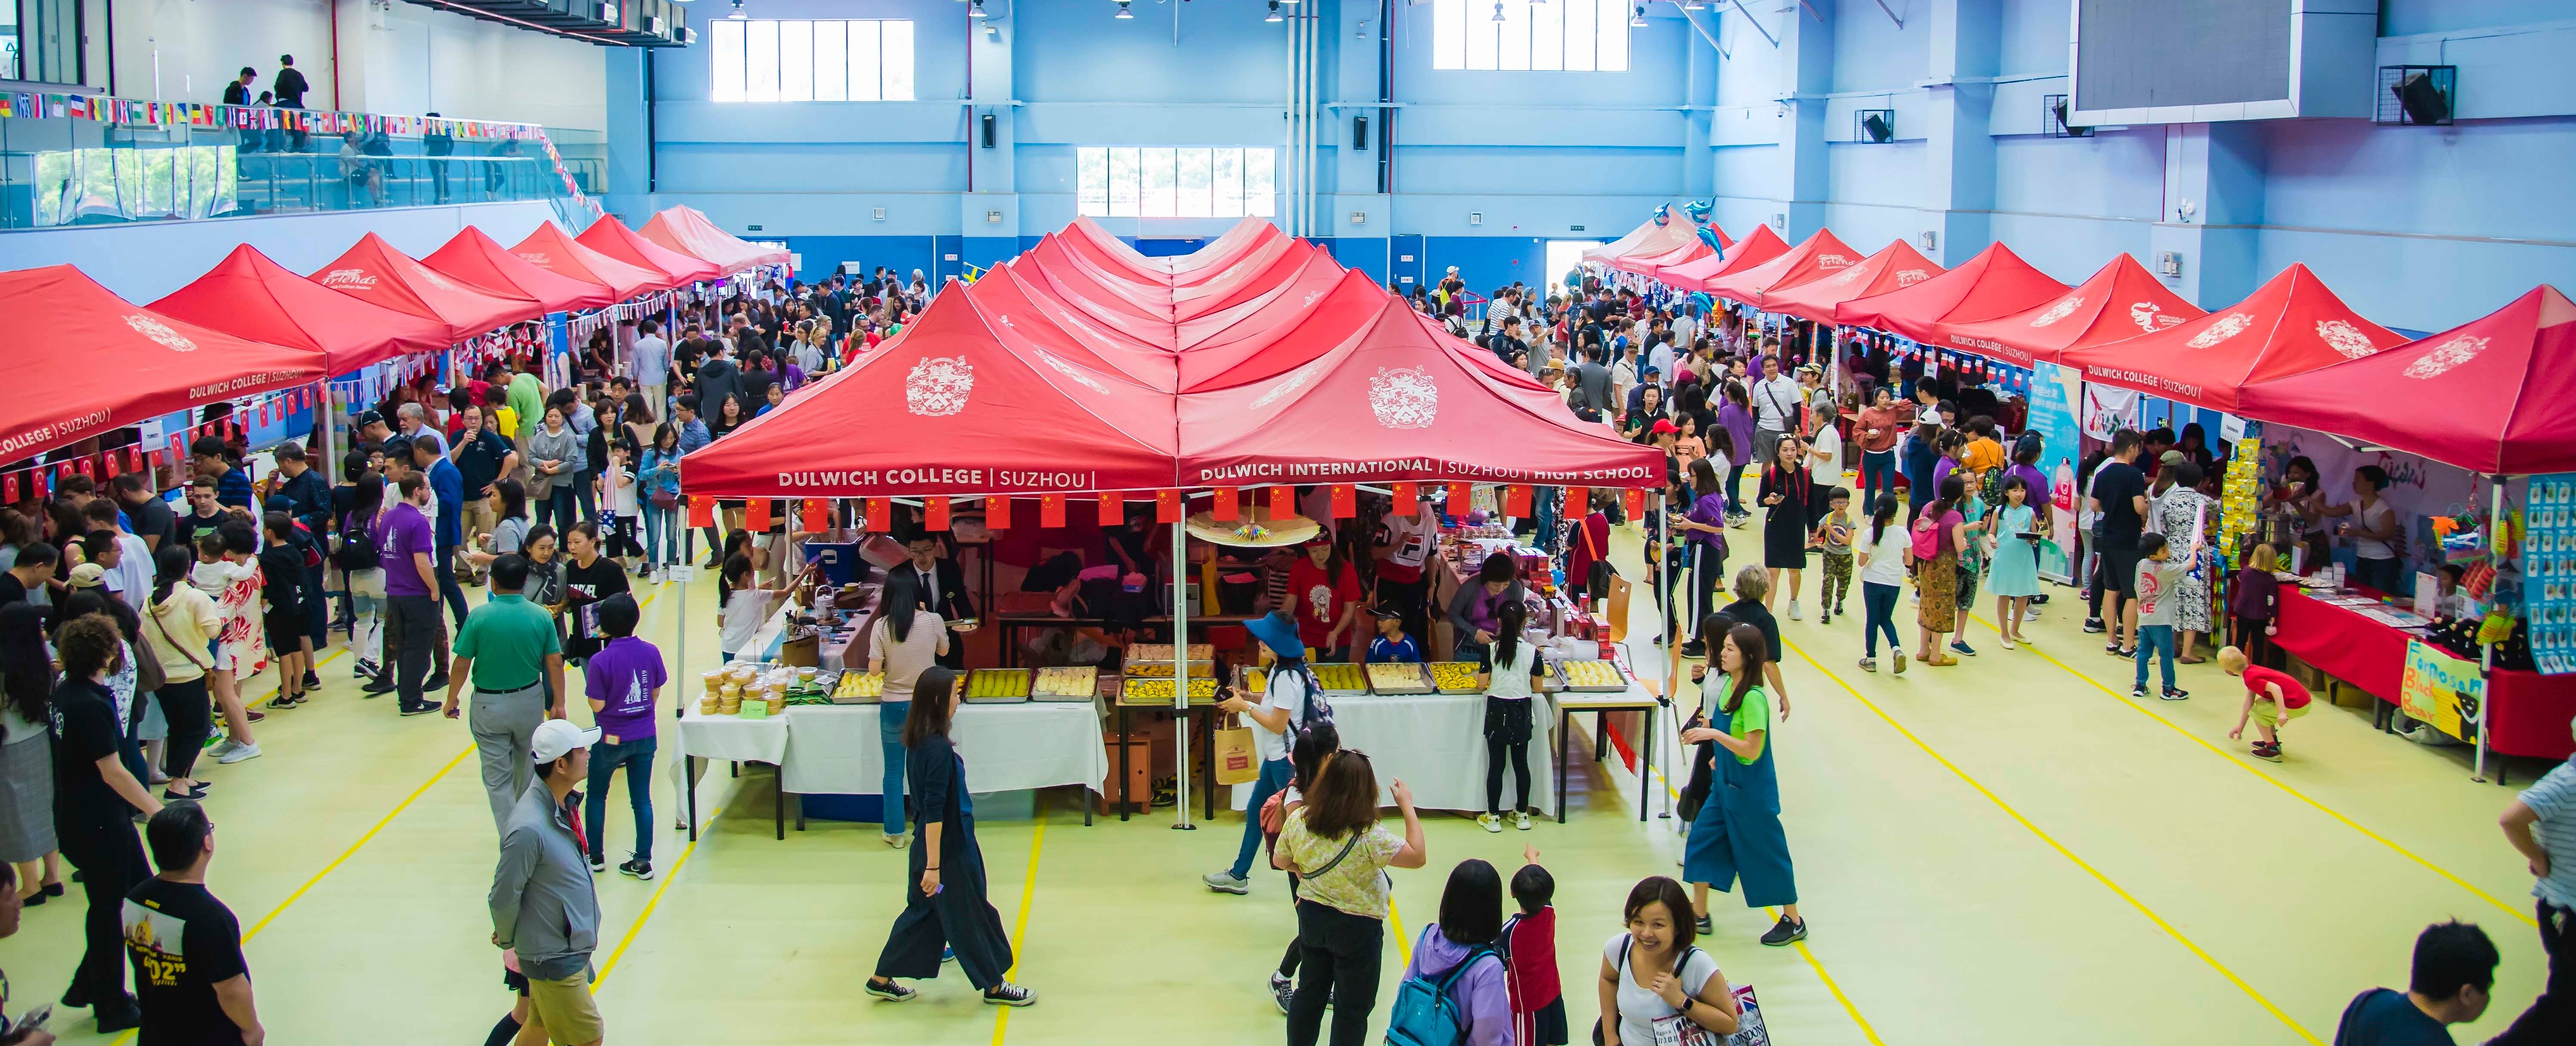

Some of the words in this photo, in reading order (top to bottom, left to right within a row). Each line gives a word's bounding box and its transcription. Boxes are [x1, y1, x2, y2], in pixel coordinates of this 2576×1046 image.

[1951, 335, 1975, 347] DULWICH
[1977, 339, 2001, 352] COLLEGE
[2005, 346, 2028, 361] SUZHOU
[189, 381, 229, 399] DULWICH
[232, 373, 267, 390] COLLEGE
[2088, 365, 2122, 380] DULWICH
[2124, 371, 2158, 387] COLLEGE
[2164, 379, 2197, 397] SUZHOU
[59, 410, 105, 435] SUZHOU
[779, 470, 877, 487] DULWICH
[886, 468, 982, 484] COLLEGE
[1000, 471, 1085, 488] SUZHOU
[1201, 463, 1282, 481] DULWICH
[1290, 459, 1432, 476] INTERNATIONAL
[1448, 461, 1519, 478] SUZHOU
[1535, 471, 1577, 480] HIGH
[1584, 466, 1652, 480] SCHOOL
[2407, 642, 2482, 692] Formosan
